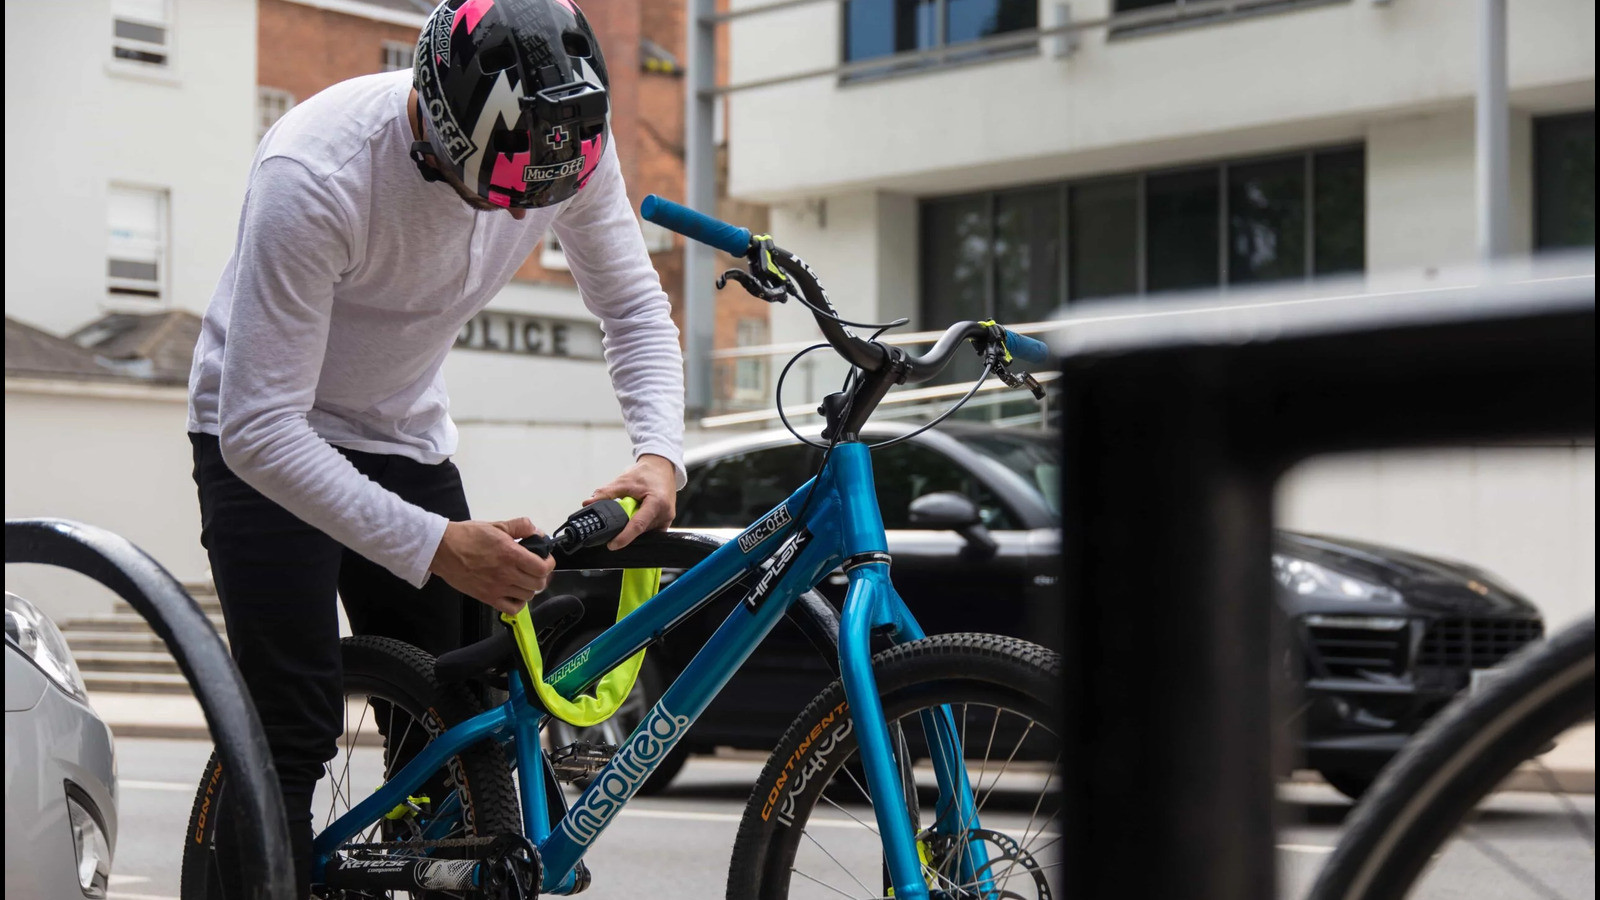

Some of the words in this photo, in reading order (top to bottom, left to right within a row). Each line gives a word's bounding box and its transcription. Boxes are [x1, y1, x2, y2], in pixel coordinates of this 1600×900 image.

[527, 161, 582, 180] Muc-Off
[453, 314, 570, 356] OLICE
[740, 507, 788, 551] Muc-Off
[543, 647, 591, 686] URPLAY
[761, 701, 849, 822] CONTINENT
[195, 762, 223, 845] CONTIN
